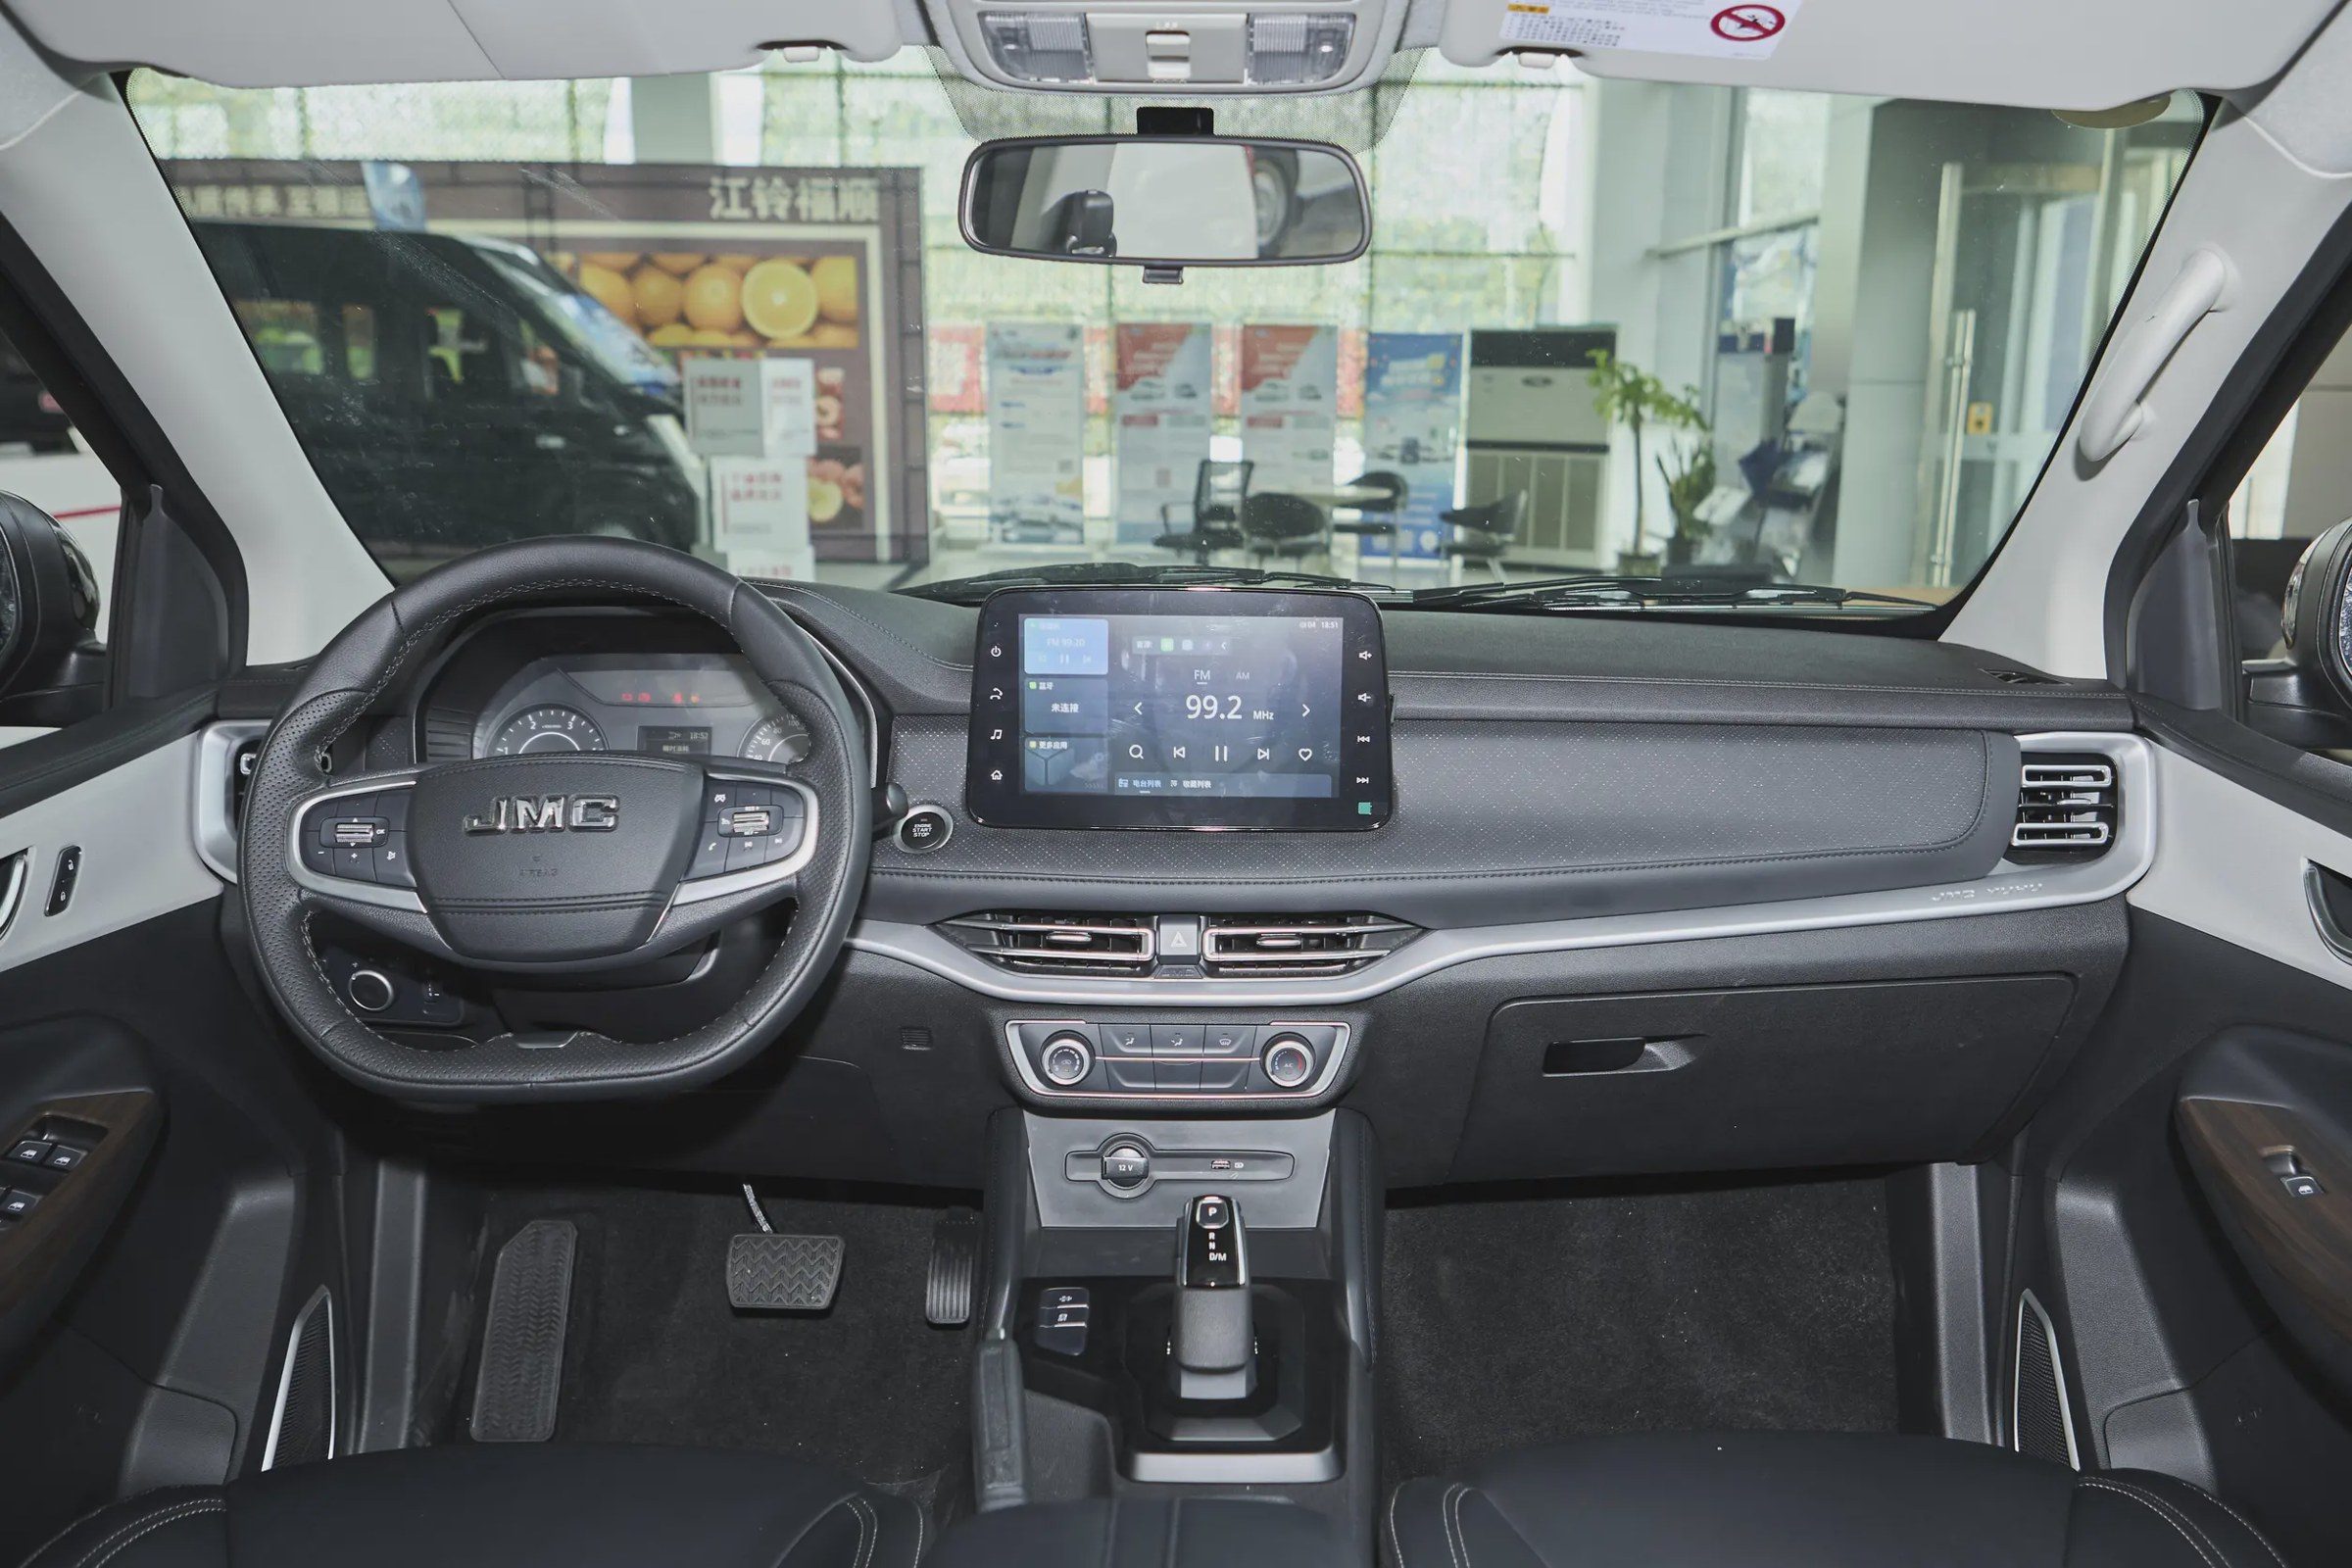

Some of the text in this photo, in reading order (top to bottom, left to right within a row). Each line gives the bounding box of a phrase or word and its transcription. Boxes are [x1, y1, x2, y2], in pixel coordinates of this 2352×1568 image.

[1194, 669, 1210, 680] FM
[1236, 671, 1250, 680] AM
[1186, 694, 1275, 720] 99.2 MHz
[530, 721, 537, 730] 2
[567, 721, 574, 730] 3
[464, 795, 619, 835] JMC
[1208, 1206, 1218, 1217] P
[1208, 1232, 1215, 1241] R
[1208, 1242, 1216, 1250] N
[1208, 1251, 1227, 1262] D/M
